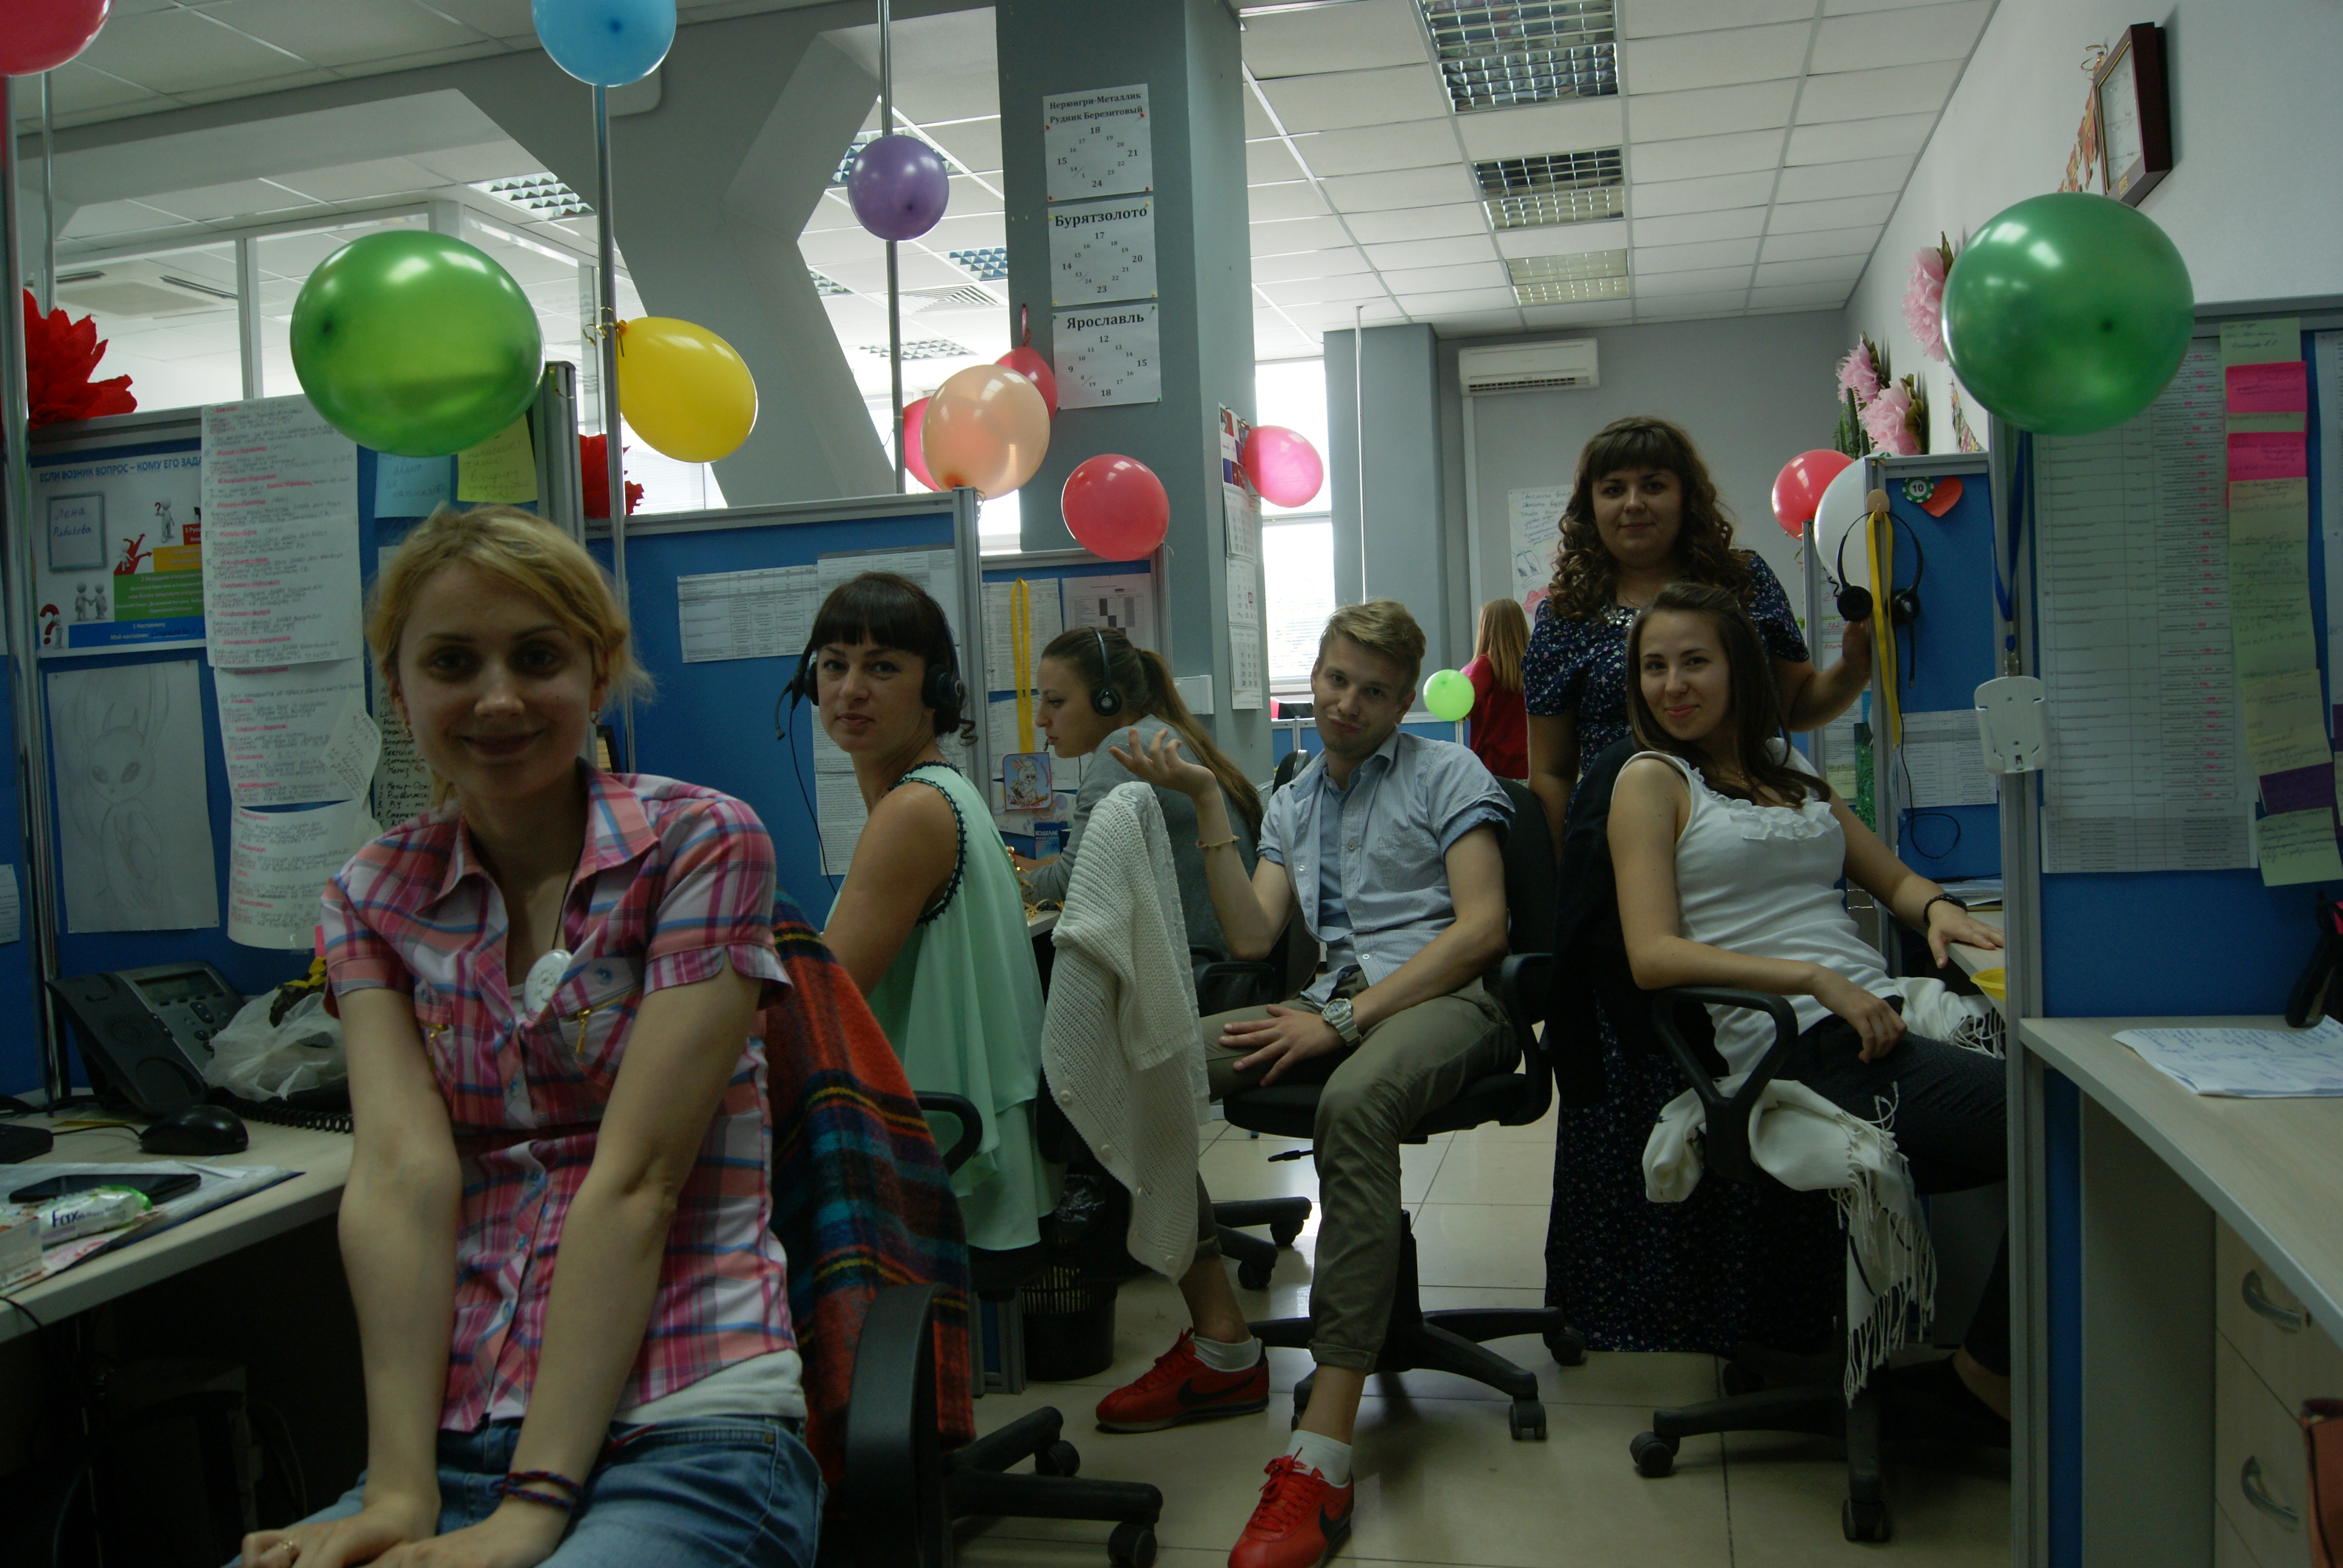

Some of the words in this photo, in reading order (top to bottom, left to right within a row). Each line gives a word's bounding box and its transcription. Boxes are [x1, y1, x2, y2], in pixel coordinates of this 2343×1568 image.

[1050, 93, 1141, 110] Нерюнгри-Металлик
[1050, 113, 1082, 125] Рудник
[1084, 105, 1143, 120] Березитовый
[1127, 149, 1138, 157] 21
[1057, 157, 1067, 165] 15
[1055, 208, 1147, 229] Бурятзолото
[1132, 255, 1143, 263] 20
[1096, 285, 1107, 293] 23
[1067, 314, 1144, 332] Ярославль
[39, 471, 60, 483] ЕСЛИ
[62, 469, 94, 480] ВОЗНИК
[95, 464, 128, 477] ВОПРОС
[137, 460, 162, 472] КОМУ
[163, 458, 179, 469] ЕГО
[1912, 484, 1924, 492] 10
